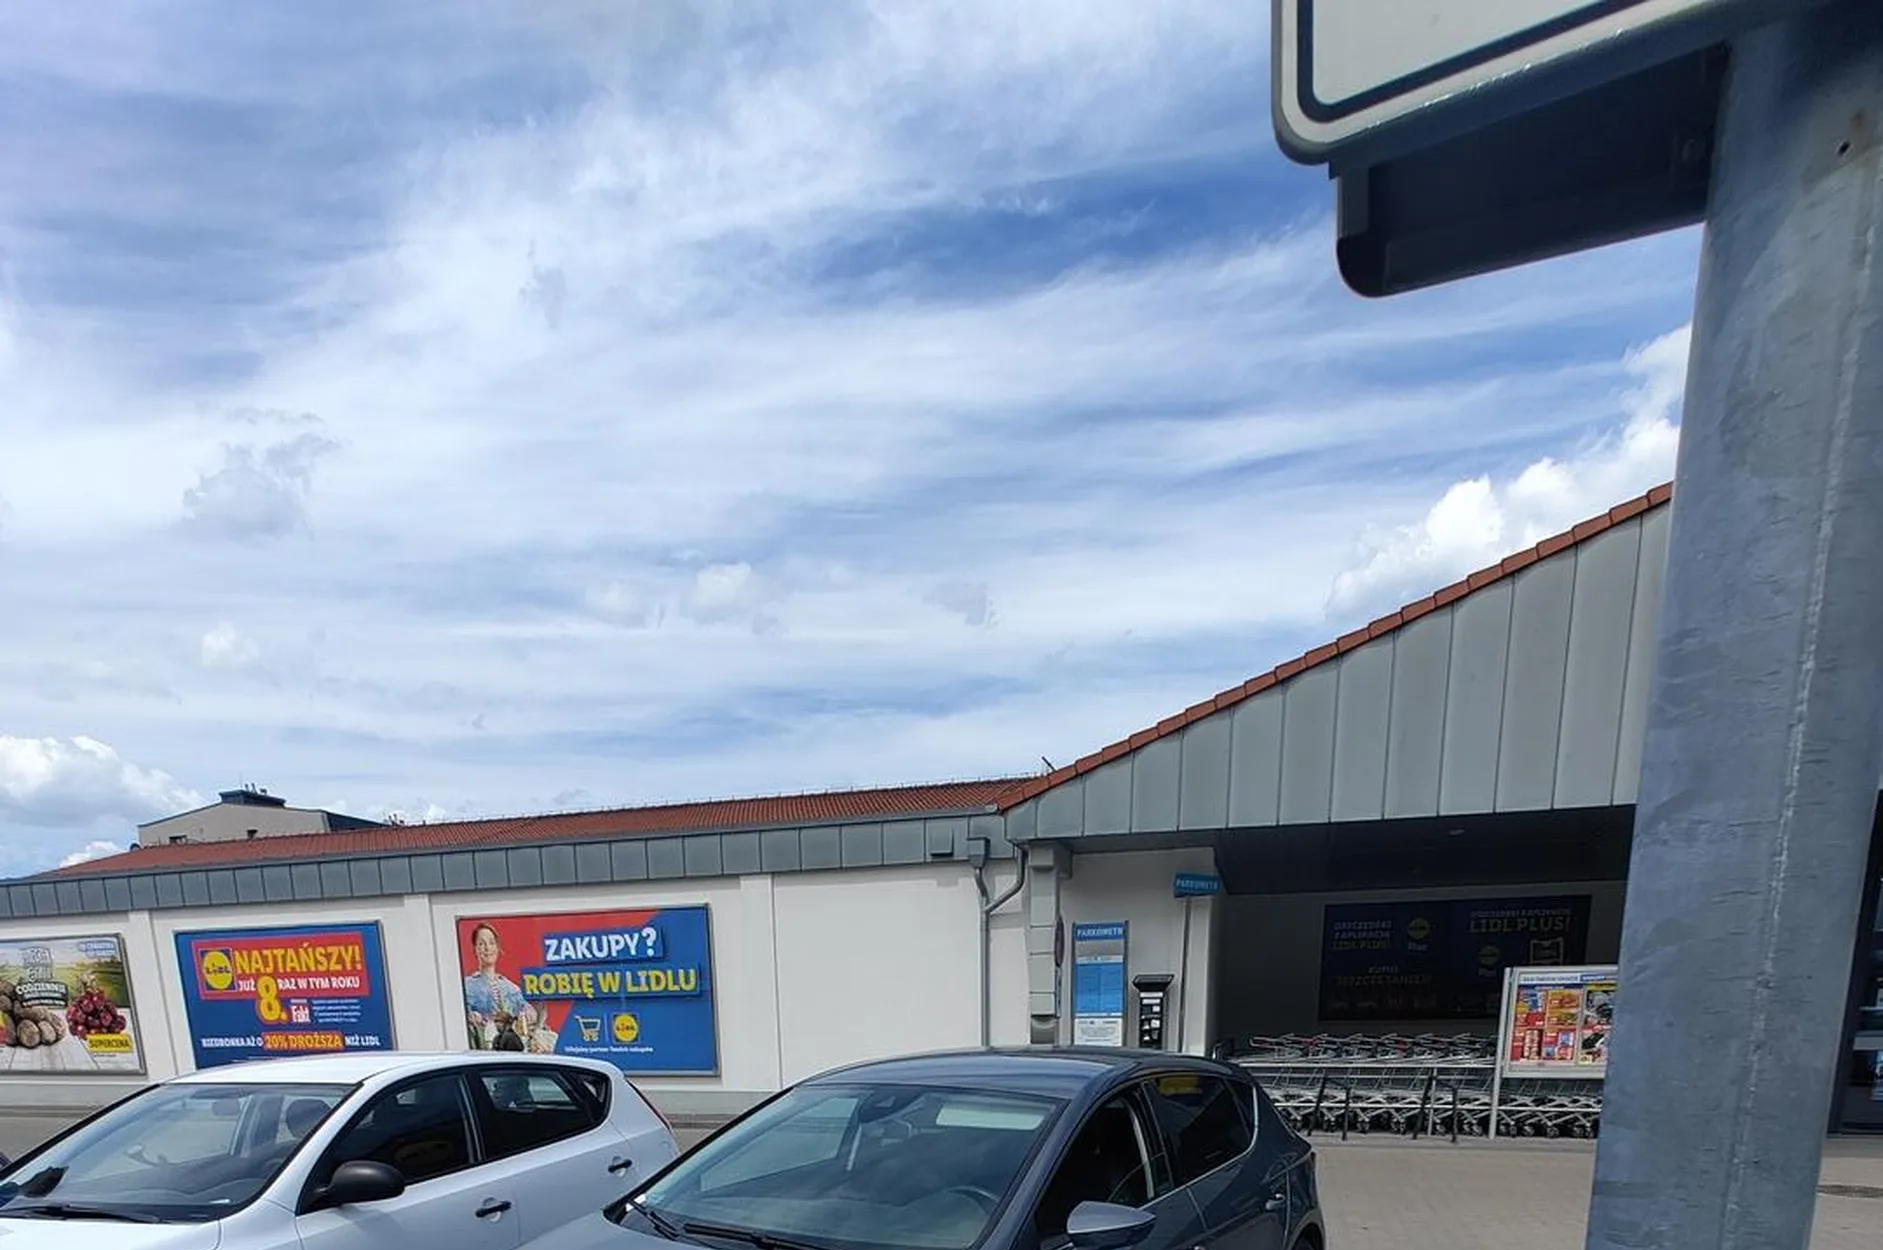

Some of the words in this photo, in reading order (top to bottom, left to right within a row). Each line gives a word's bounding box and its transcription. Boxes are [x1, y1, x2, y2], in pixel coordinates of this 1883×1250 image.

[1077, 928, 1123, 937] PARKOMETR
[1470, 918, 1513, 933] LIDL
[233, 942, 362, 974] NAJTAŃSZY!
[545, 927, 658, 962] ZAKUPY?
[238, 979, 256, 991] JUŻ
[257, 976, 288, 1022] 8.
[298, 977, 308, 988] W
[308, 977, 330, 988] TYM
[332, 976, 360, 988] ROKU
[523, 971, 594, 999] ROBIĘ
[597, 971, 621, 993] W
[626, 968, 697, 993] LIDLU
[266, 1035, 287, 1048] 20%
[288, 1032, 342, 1048] DROŻSZA
[345, 1035, 360, 1046] NIŻ
[361, 1036, 381, 1046] LIDL
